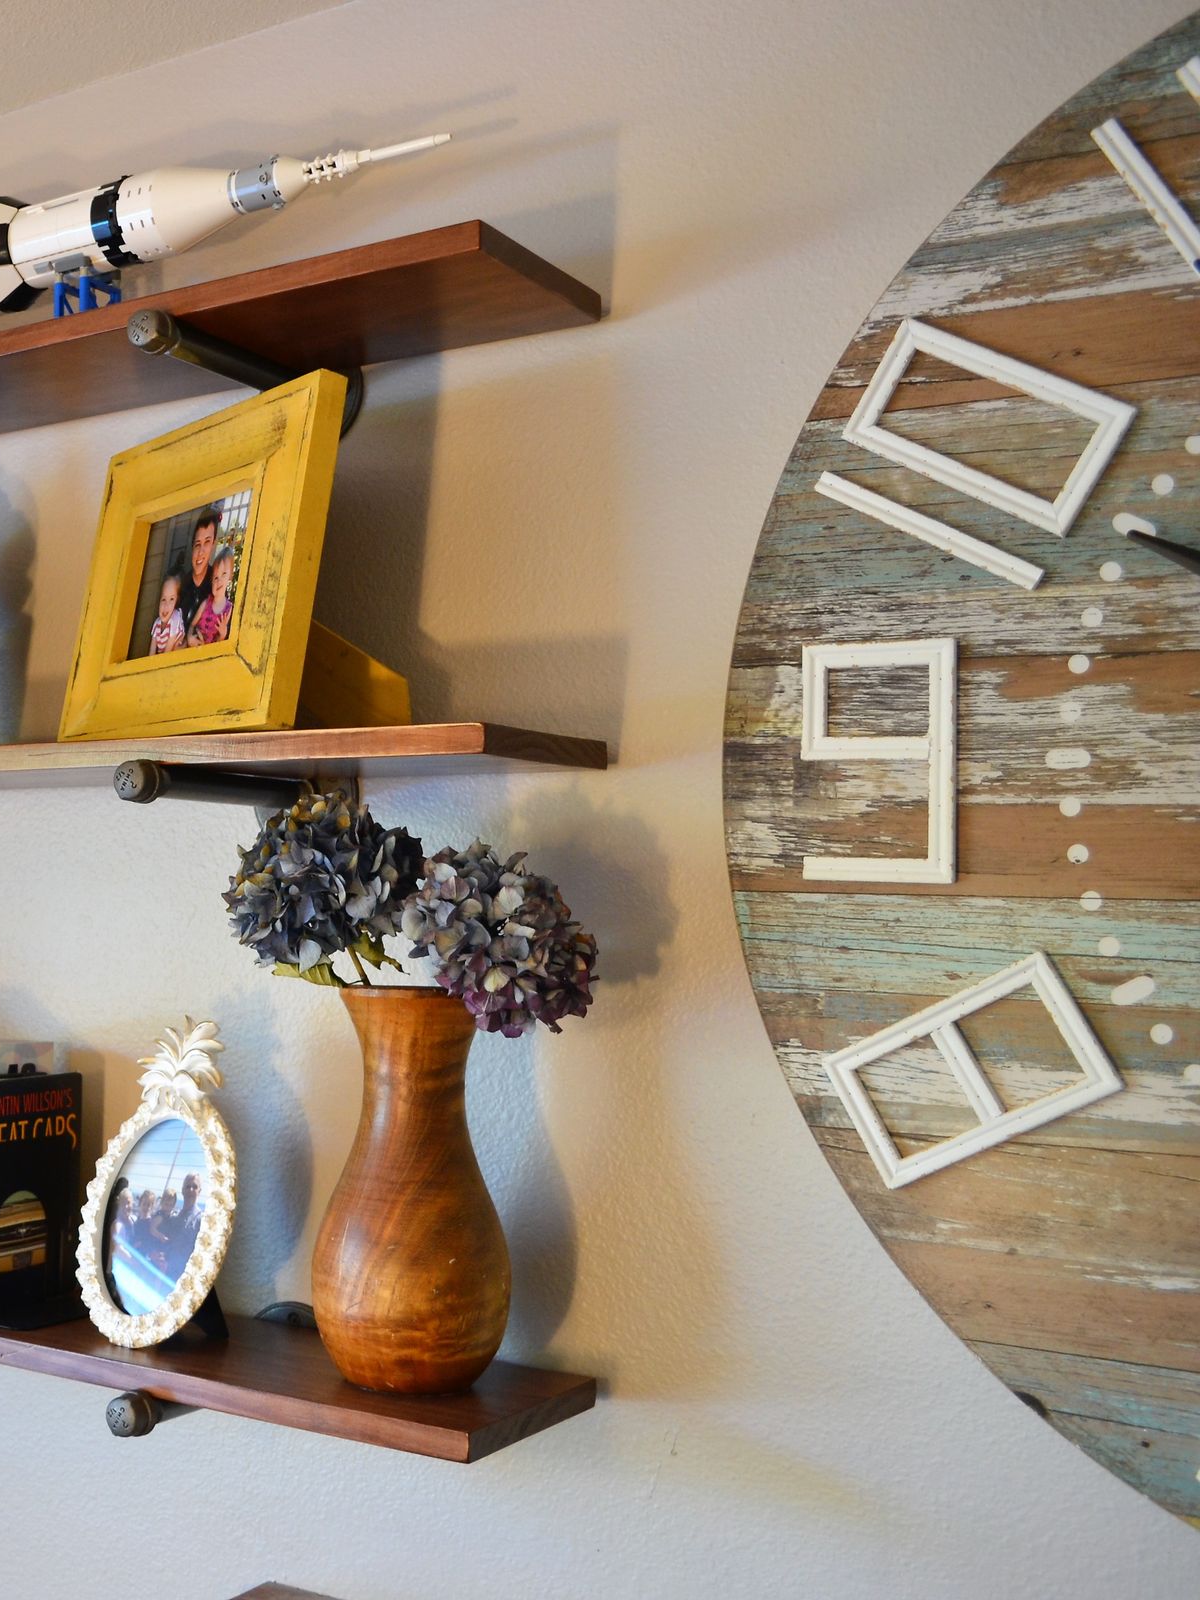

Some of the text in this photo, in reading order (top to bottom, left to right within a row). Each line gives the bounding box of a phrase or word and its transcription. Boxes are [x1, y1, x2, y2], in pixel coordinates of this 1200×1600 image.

[130, 320, 149, 334] CHINA
[800, 636, 958, 884] 9
[120, 768, 134, 791] CHINA
[822, 950, 1126, 1190] 8
[23, 1087, 72, 1114] WILLSON'S
[112, 1407, 125, 1428] CHINA
